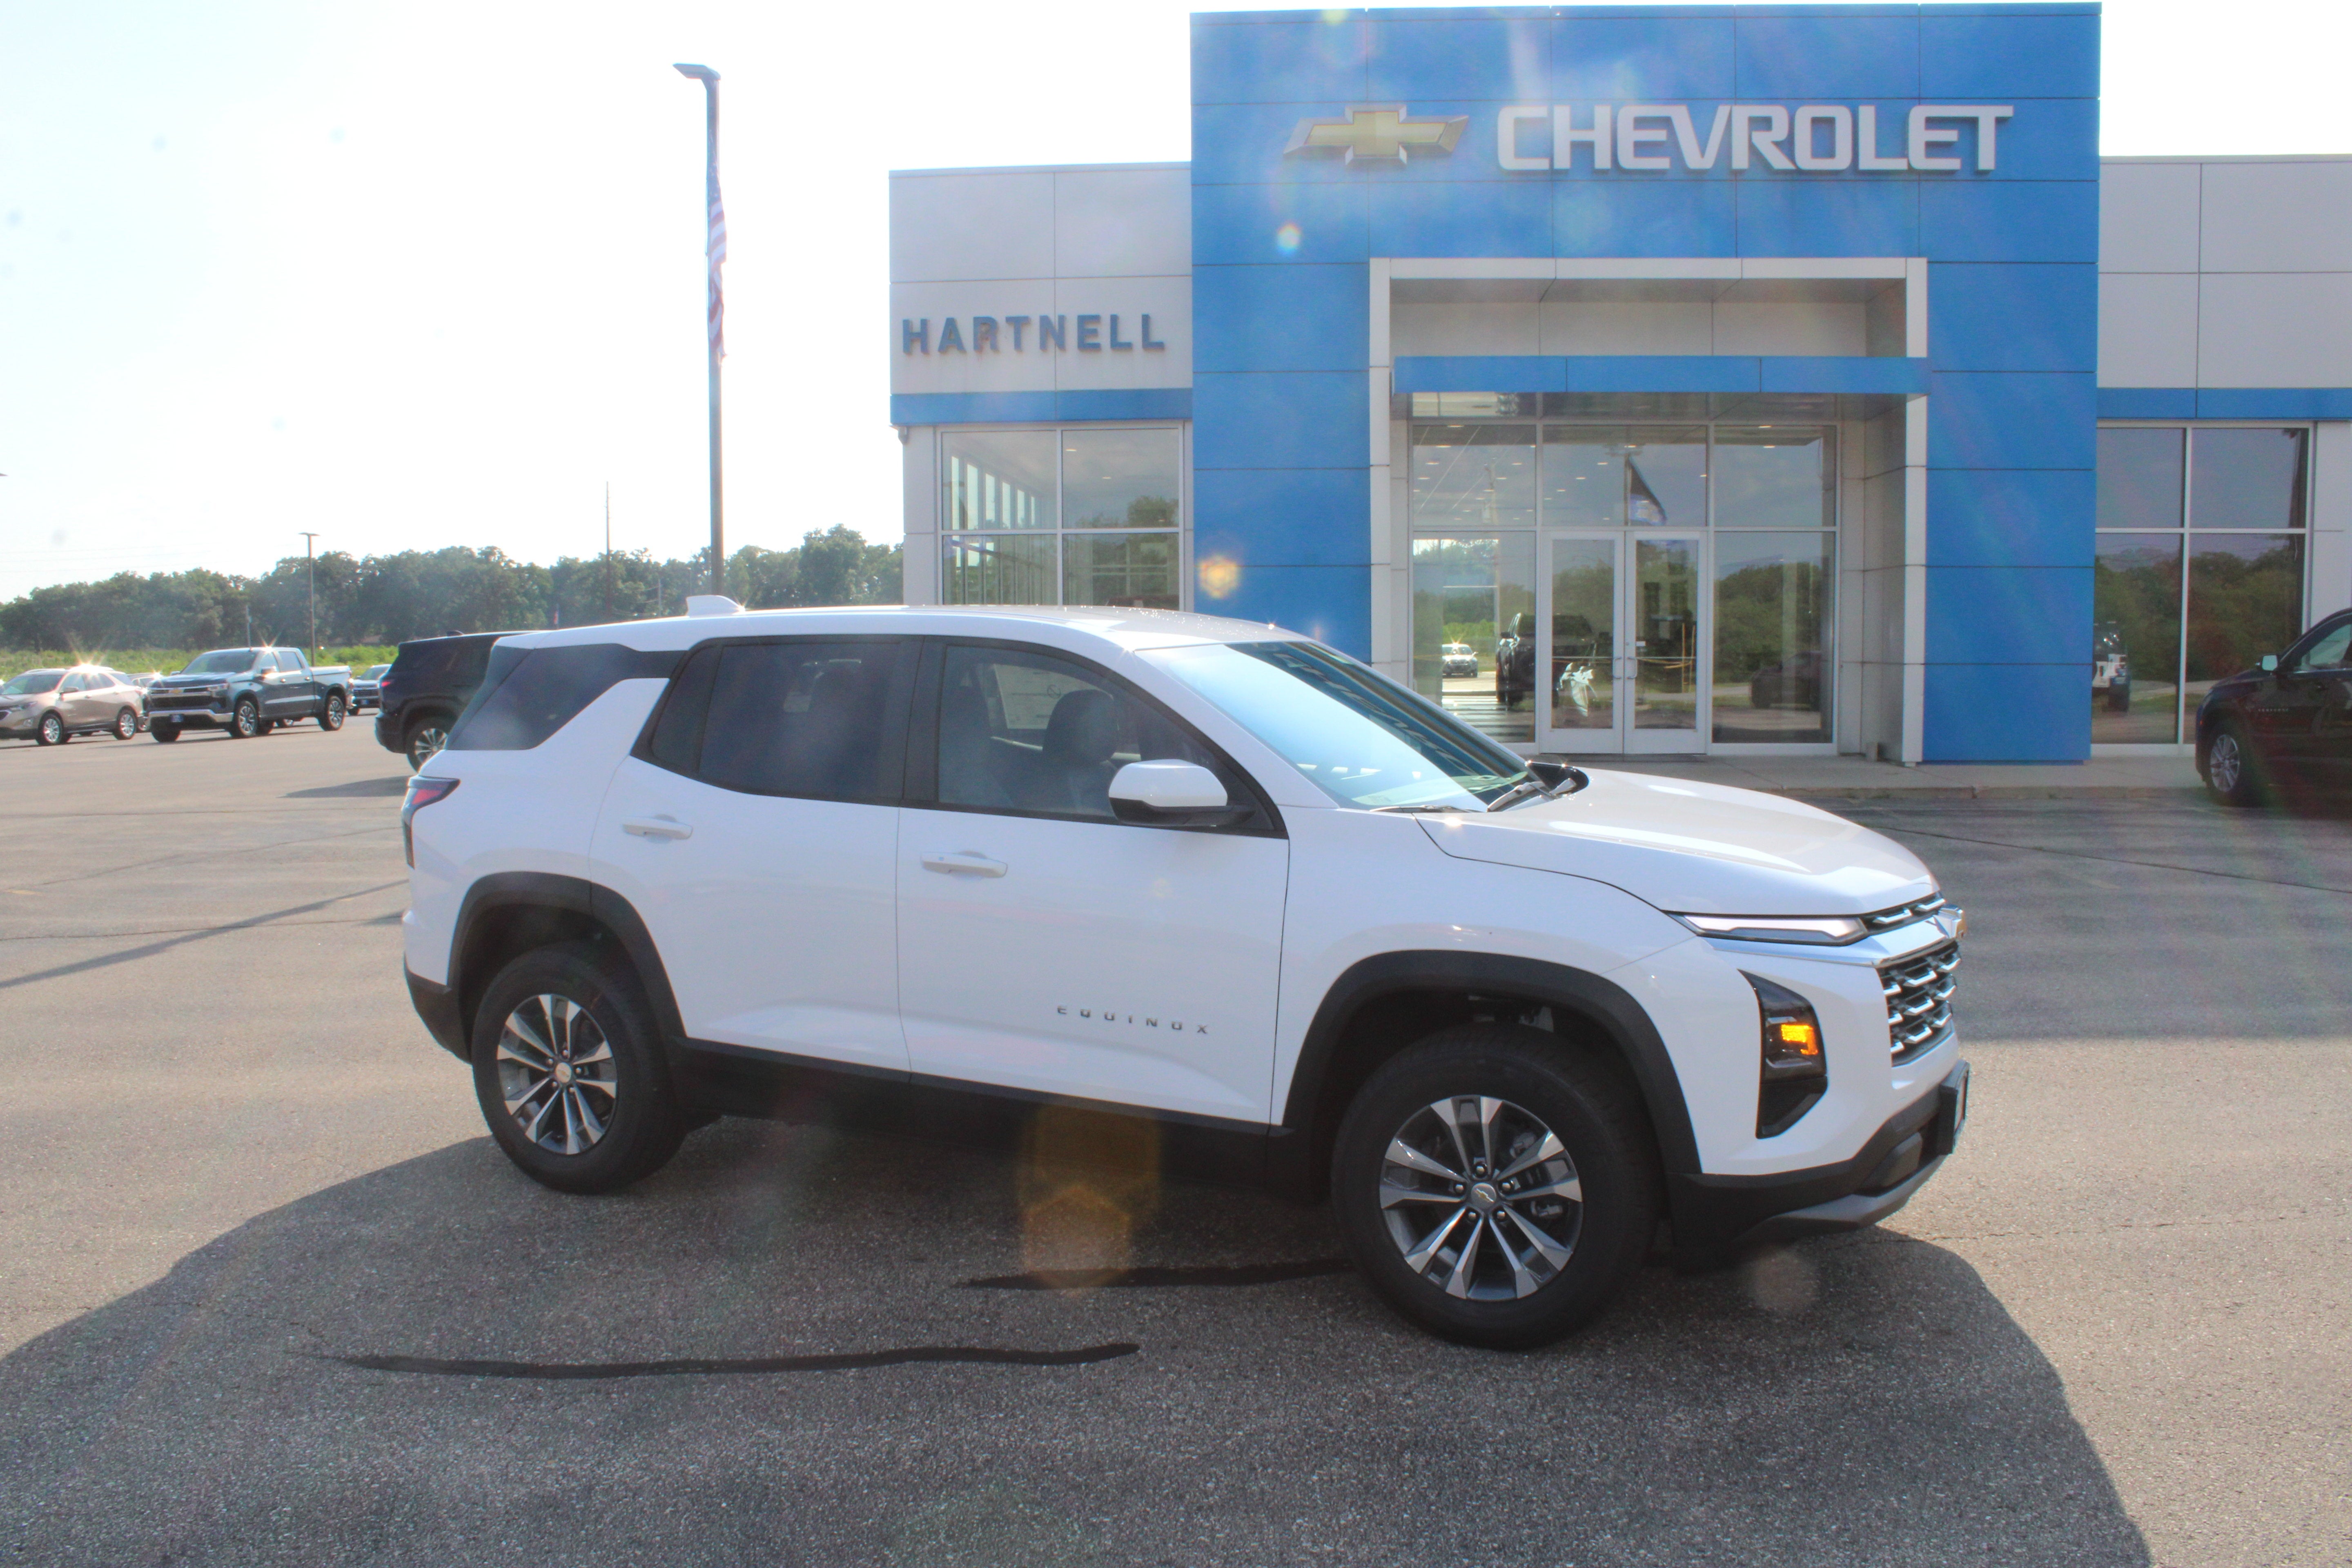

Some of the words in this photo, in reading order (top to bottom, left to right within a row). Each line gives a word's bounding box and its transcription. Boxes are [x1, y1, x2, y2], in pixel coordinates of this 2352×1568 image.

[1497, 105, 2014, 171] CHEVROLET
[902, 314, 1165, 354] HARTNELL
[1057, 1005, 1207, 1034] EQUINOX
